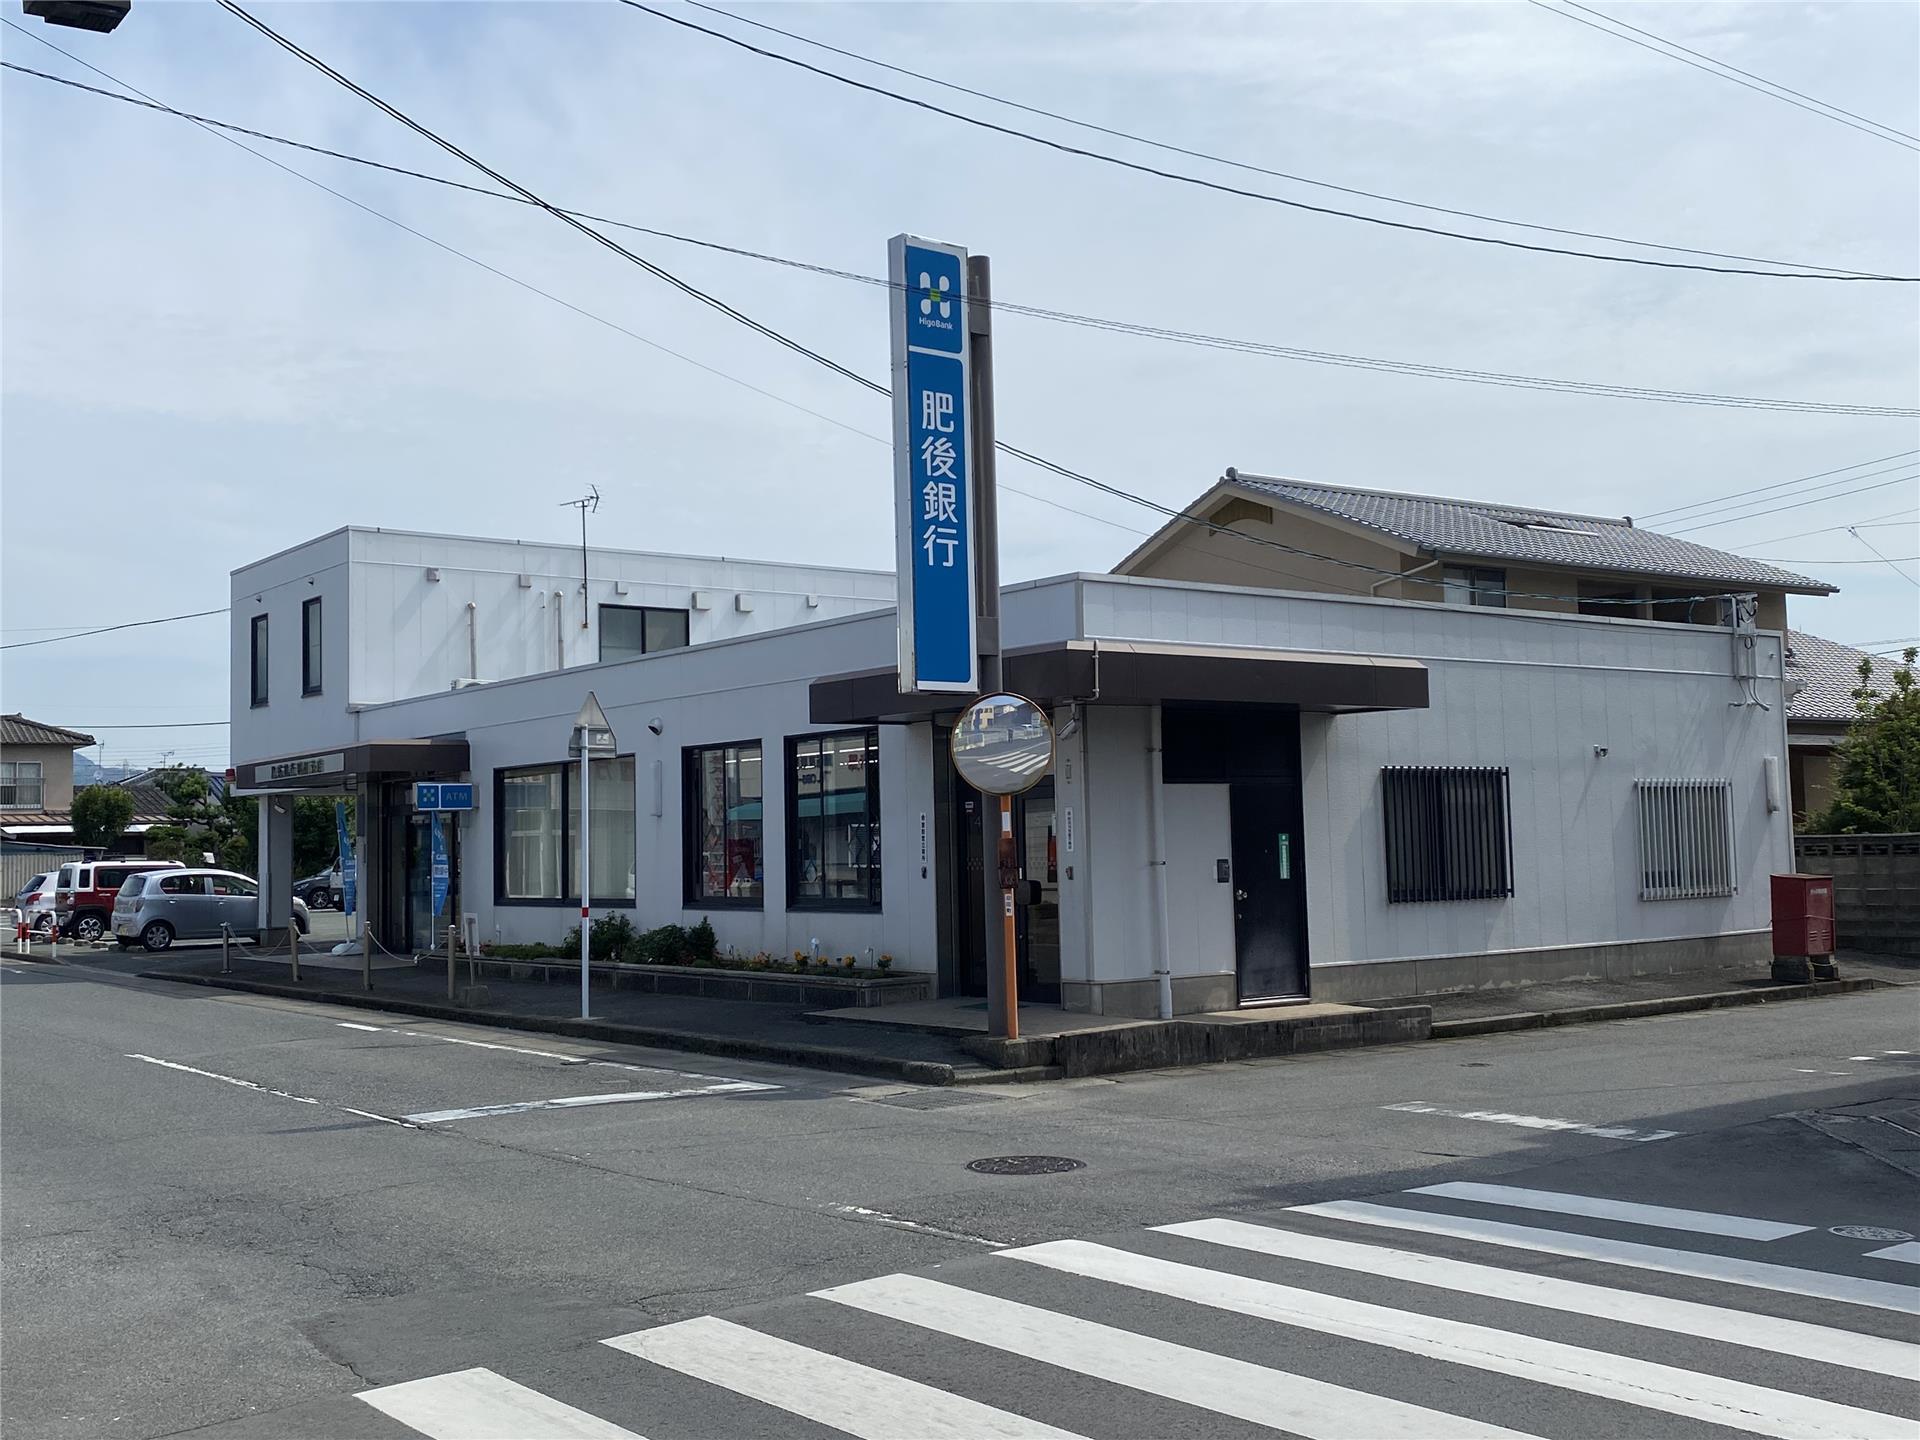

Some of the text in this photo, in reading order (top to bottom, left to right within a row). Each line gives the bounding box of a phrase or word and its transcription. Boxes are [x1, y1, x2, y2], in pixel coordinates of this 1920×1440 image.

[919, 316, 953, 330] HigoBank
[921, 390, 959, 567] 肥後銀行
[446, 792, 468, 801] ATM
